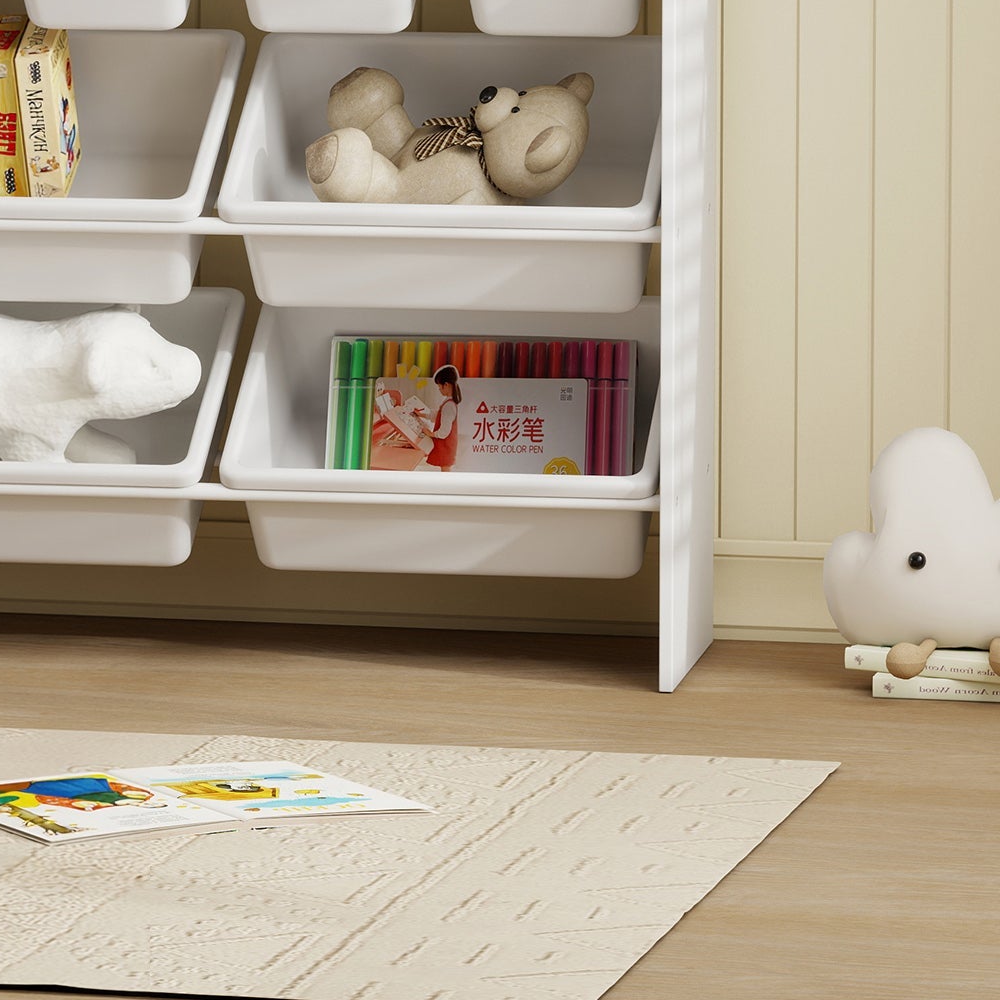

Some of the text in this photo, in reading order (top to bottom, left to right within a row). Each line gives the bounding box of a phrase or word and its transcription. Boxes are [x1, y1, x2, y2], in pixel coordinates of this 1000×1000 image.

[25, 89, 49, 153] Манчкин
[490, 405, 537, 414] 大容量三角杆
[472, 417, 545, 443] 水彩笔
[472, 445, 544, 454] WATER COLOR PEN
